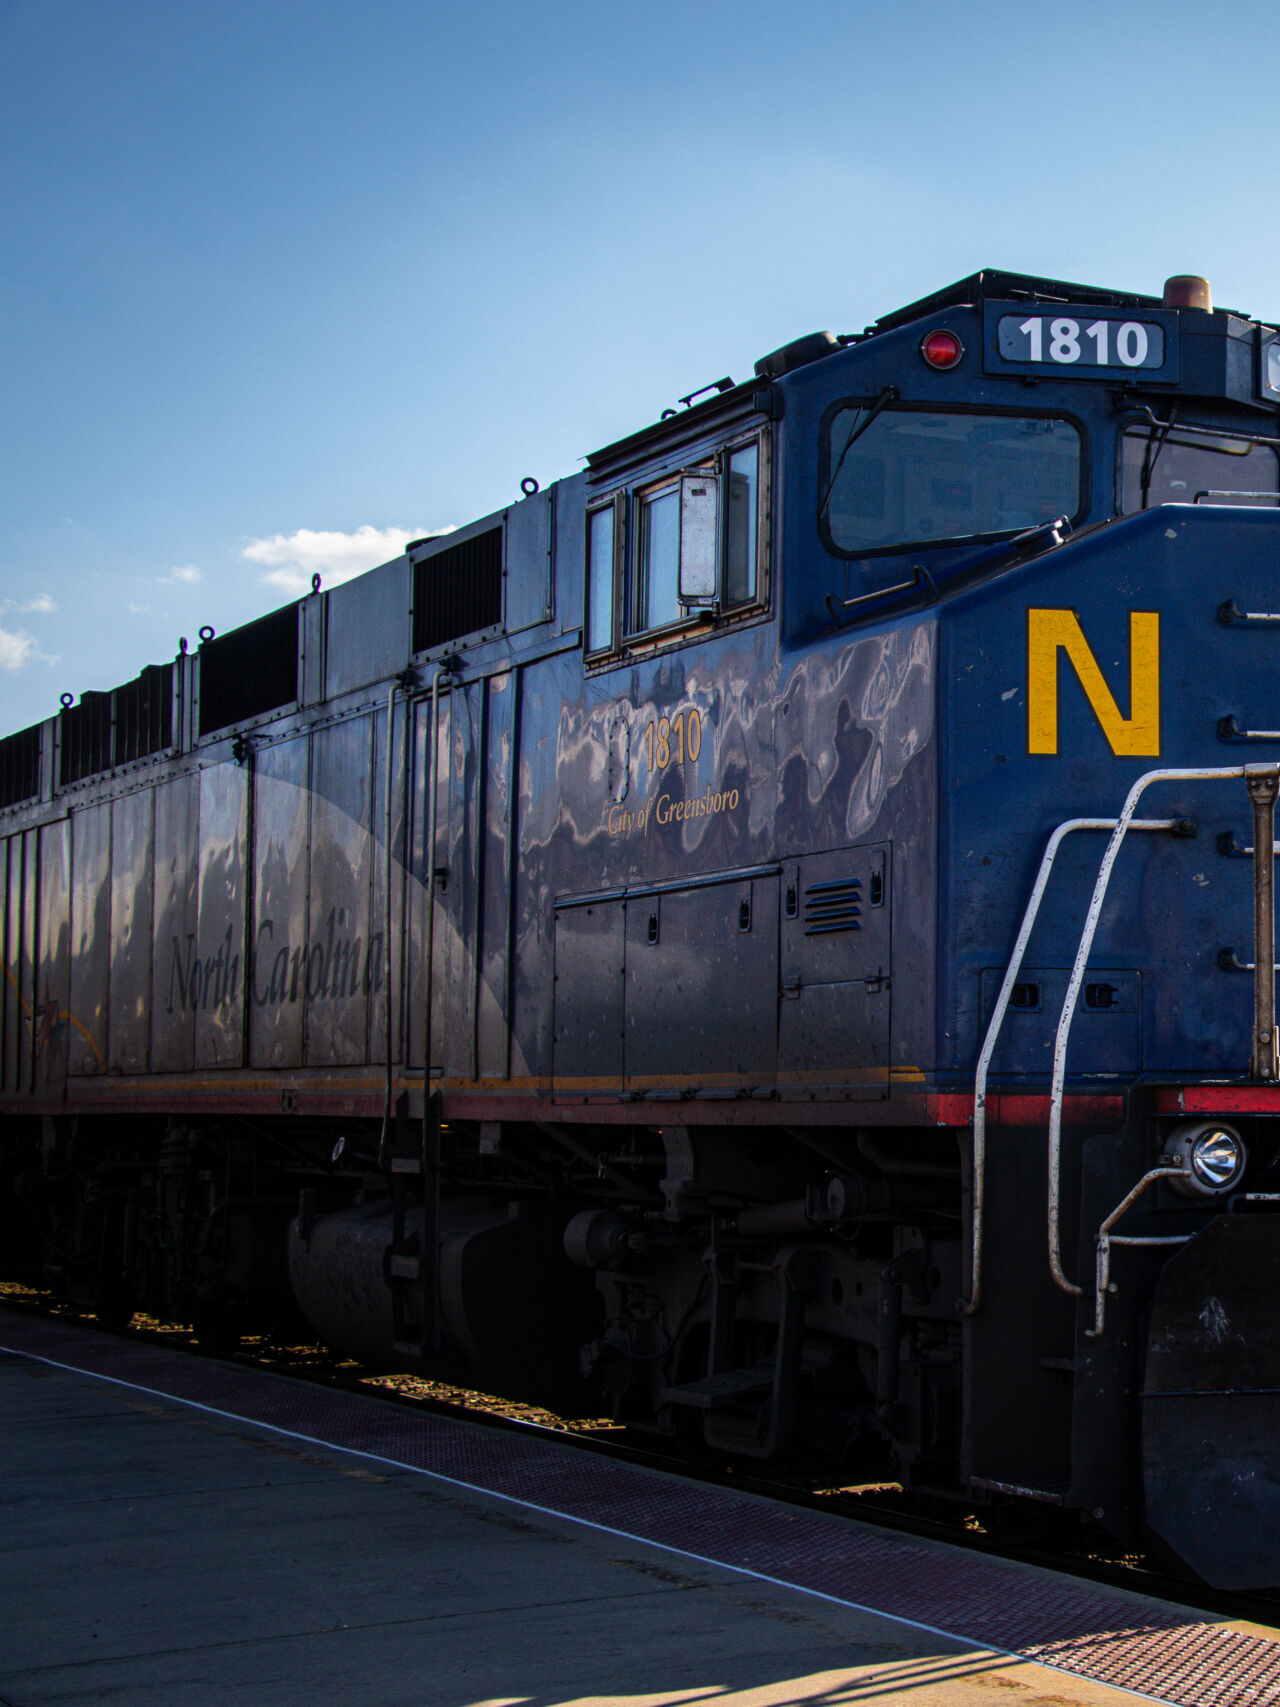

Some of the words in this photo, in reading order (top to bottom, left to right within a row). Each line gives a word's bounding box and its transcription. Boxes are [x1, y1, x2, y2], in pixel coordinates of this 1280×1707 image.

[1019, 317, 1149, 367] 1810
[1026, 607, 1161, 758] N
[644, 709, 702, 773] 1810
[608, 804, 634, 841] City
[637, 797, 652, 837] of
[655, 783, 740, 825] Greensboro
[166, 922, 240, 1014] North
[252, 906, 384, 1007] Carolina
